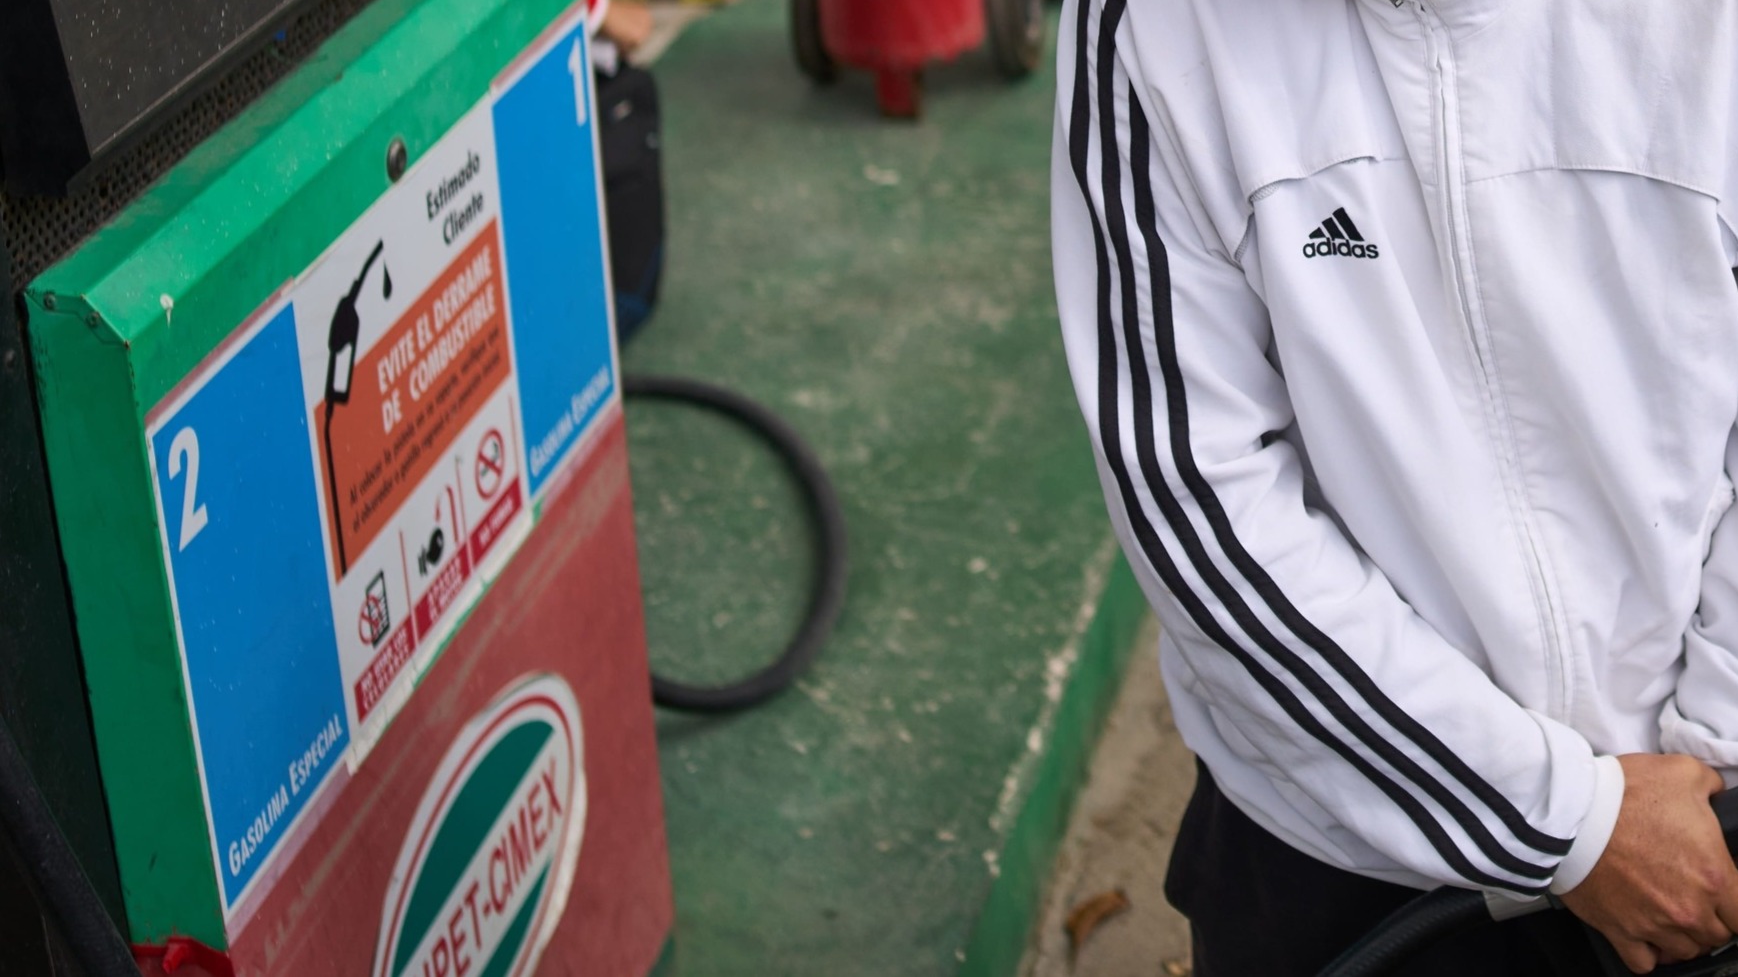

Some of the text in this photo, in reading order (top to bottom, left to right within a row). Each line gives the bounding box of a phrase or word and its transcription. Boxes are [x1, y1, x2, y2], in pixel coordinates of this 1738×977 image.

[568, 36, 588, 127] 1
[426, 149, 480, 221] Estimado
[443, 192, 483, 246] Cliente
[1303, 237, 1379, 259] adidas
[377, 246, 492, 392] EVITE EL DERRAME
[382, 284, 495, 433] DE COMBUSTIBLE
[168, 426, 208, 553] 2
[228, 714, 344, 878] GASOLINA ESPECIAL
